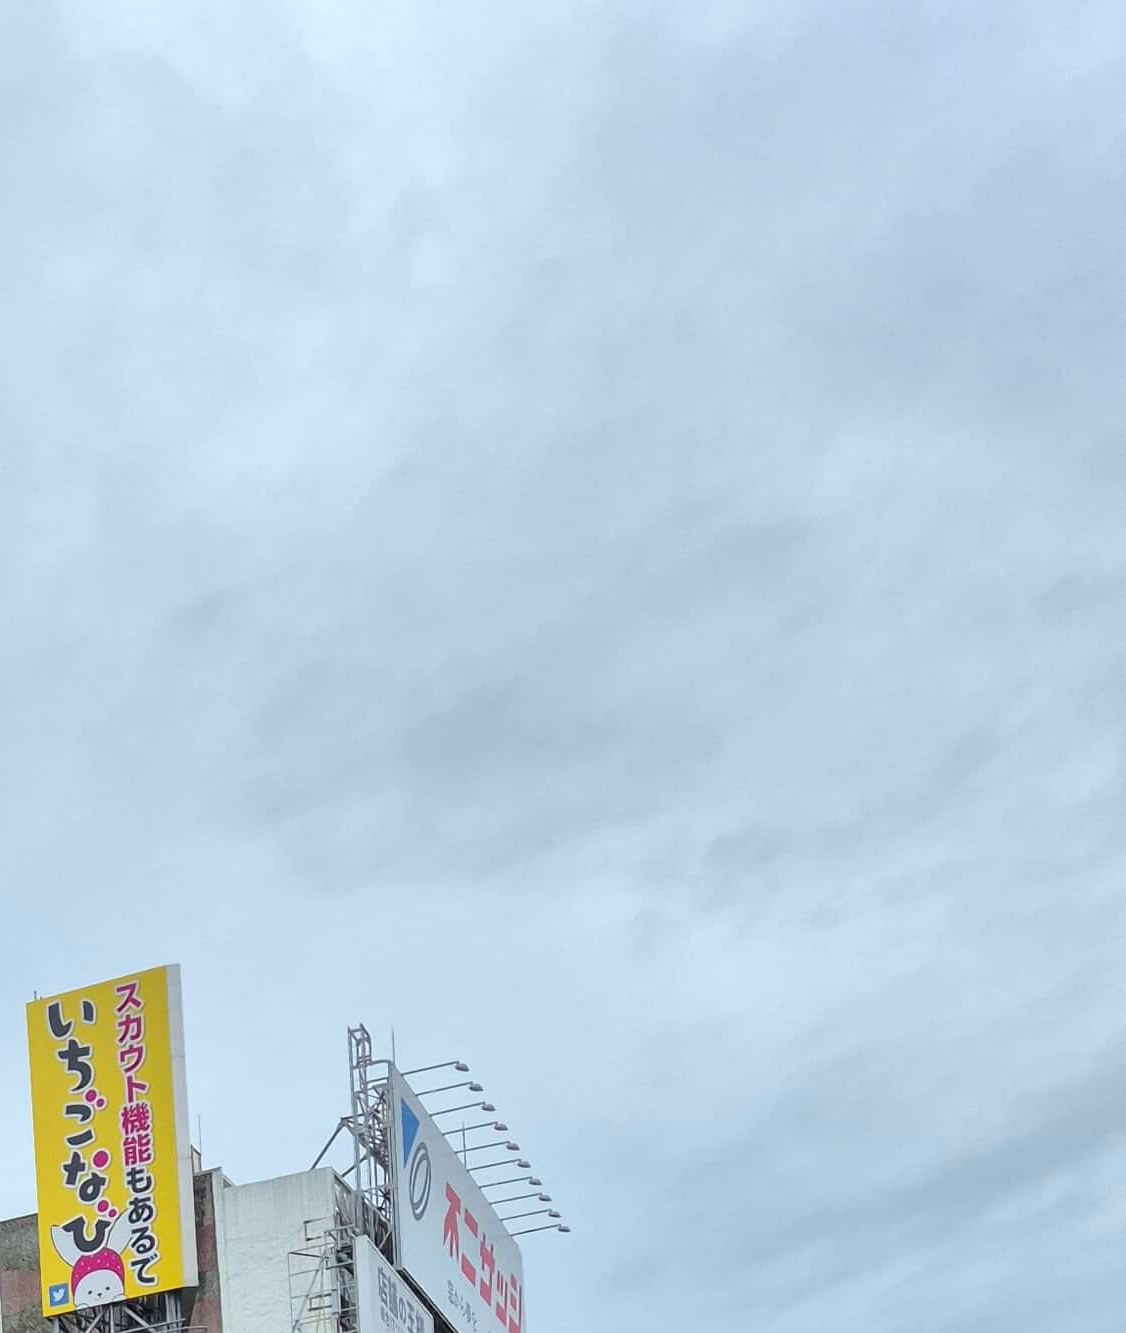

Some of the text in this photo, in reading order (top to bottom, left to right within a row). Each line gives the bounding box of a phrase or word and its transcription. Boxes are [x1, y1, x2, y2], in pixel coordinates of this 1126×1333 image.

[47, 999, 112, 1255] いちごなび
[115, 981, 159, 1286] スカウト機能もあるで
